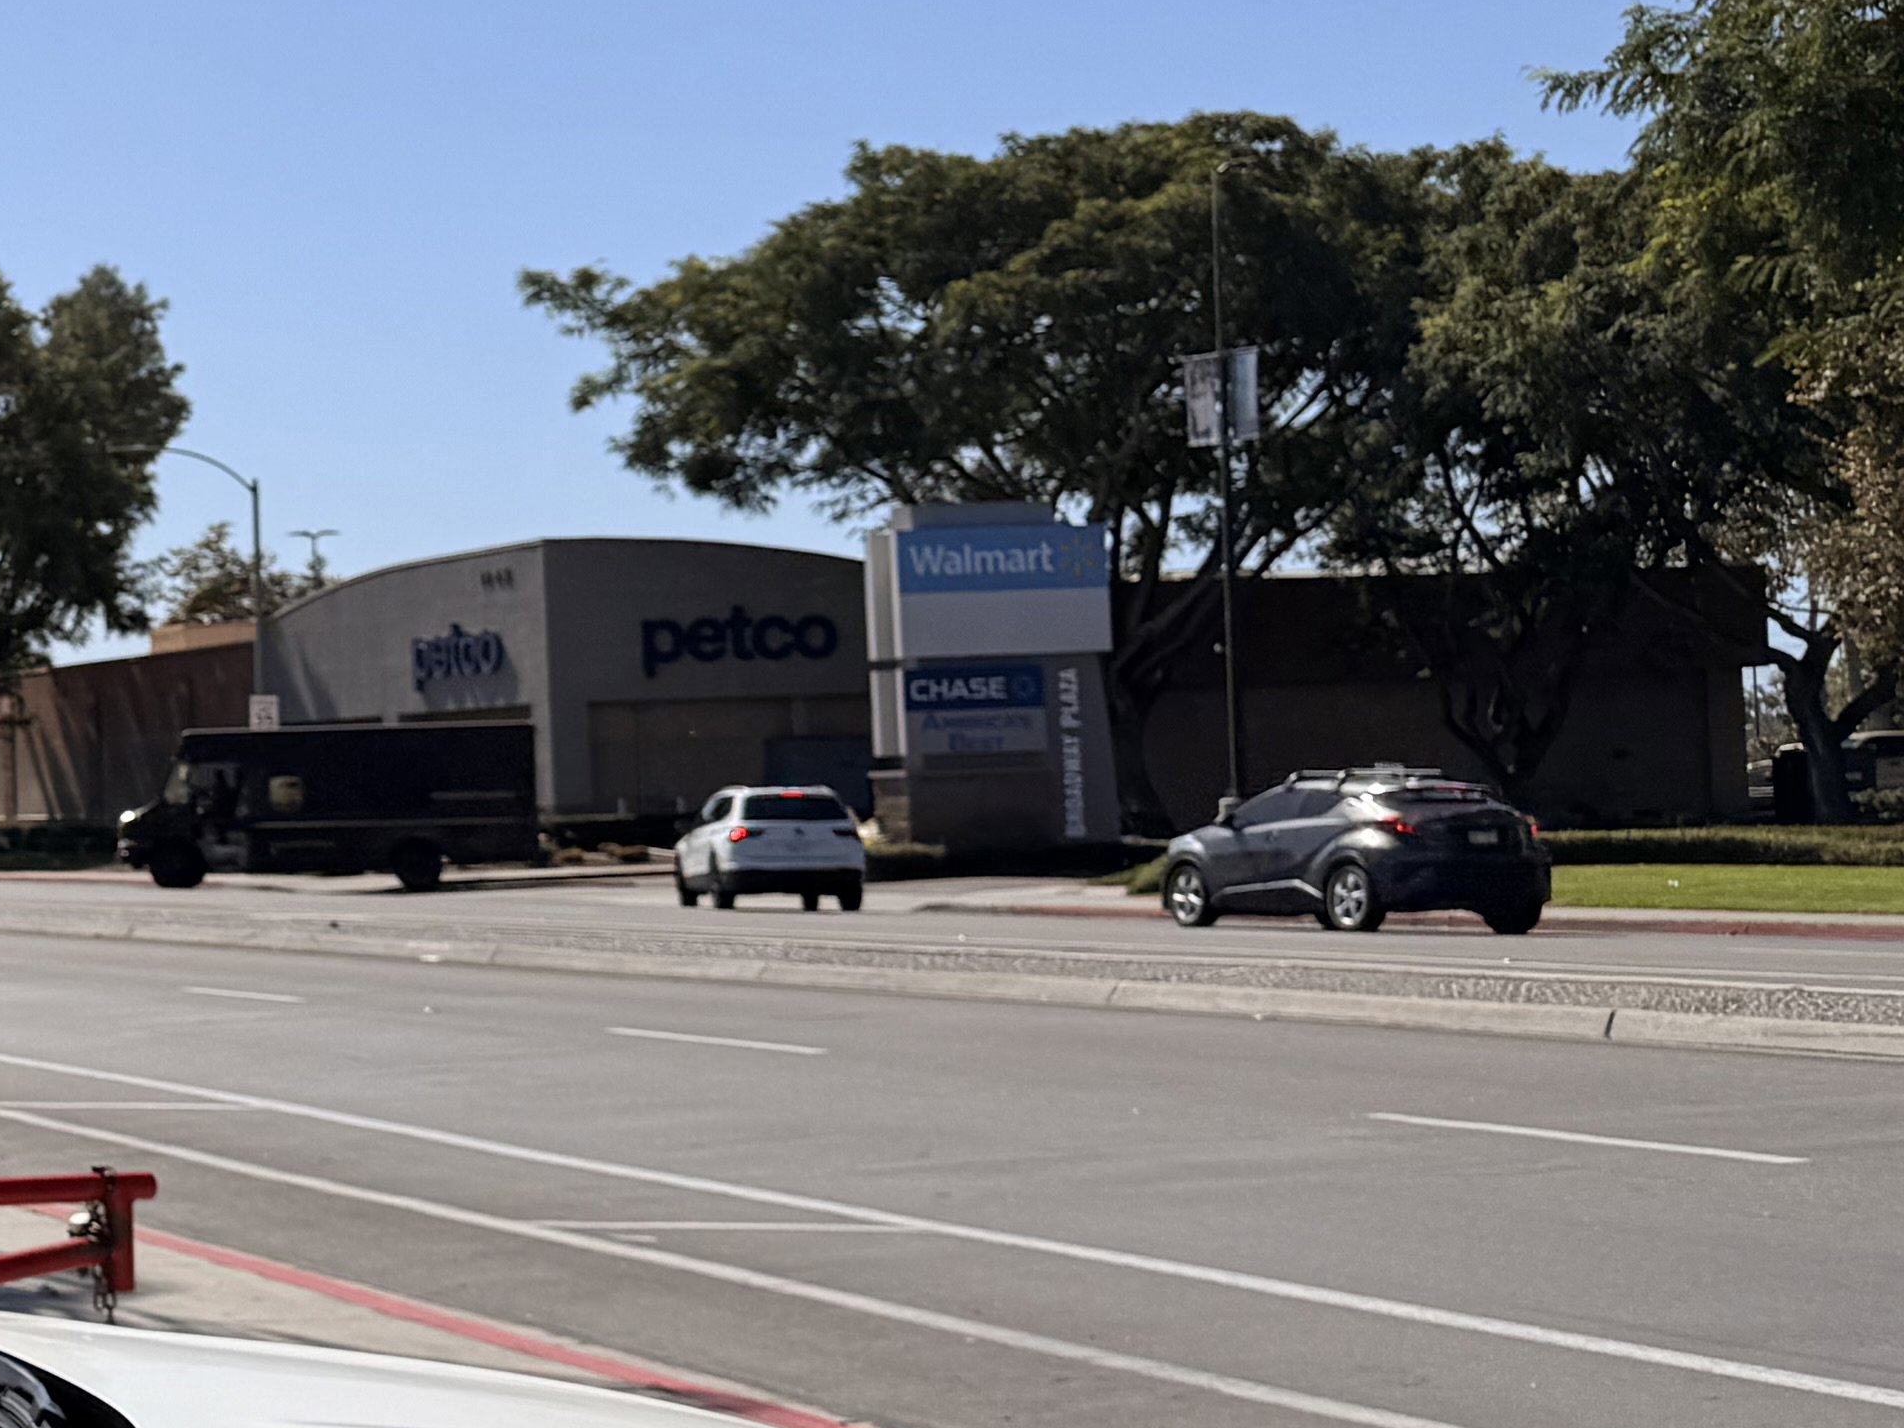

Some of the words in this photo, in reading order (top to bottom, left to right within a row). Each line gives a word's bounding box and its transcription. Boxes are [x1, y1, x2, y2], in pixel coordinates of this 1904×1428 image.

[909, 542, 1054, 576] Walmart
[412, 623, 505, 693] petco
[641, 604, 839, 679] petco
[909, 676, 1008, 703] CHASE
[1058, 668, 1083, 730] PLAZA
